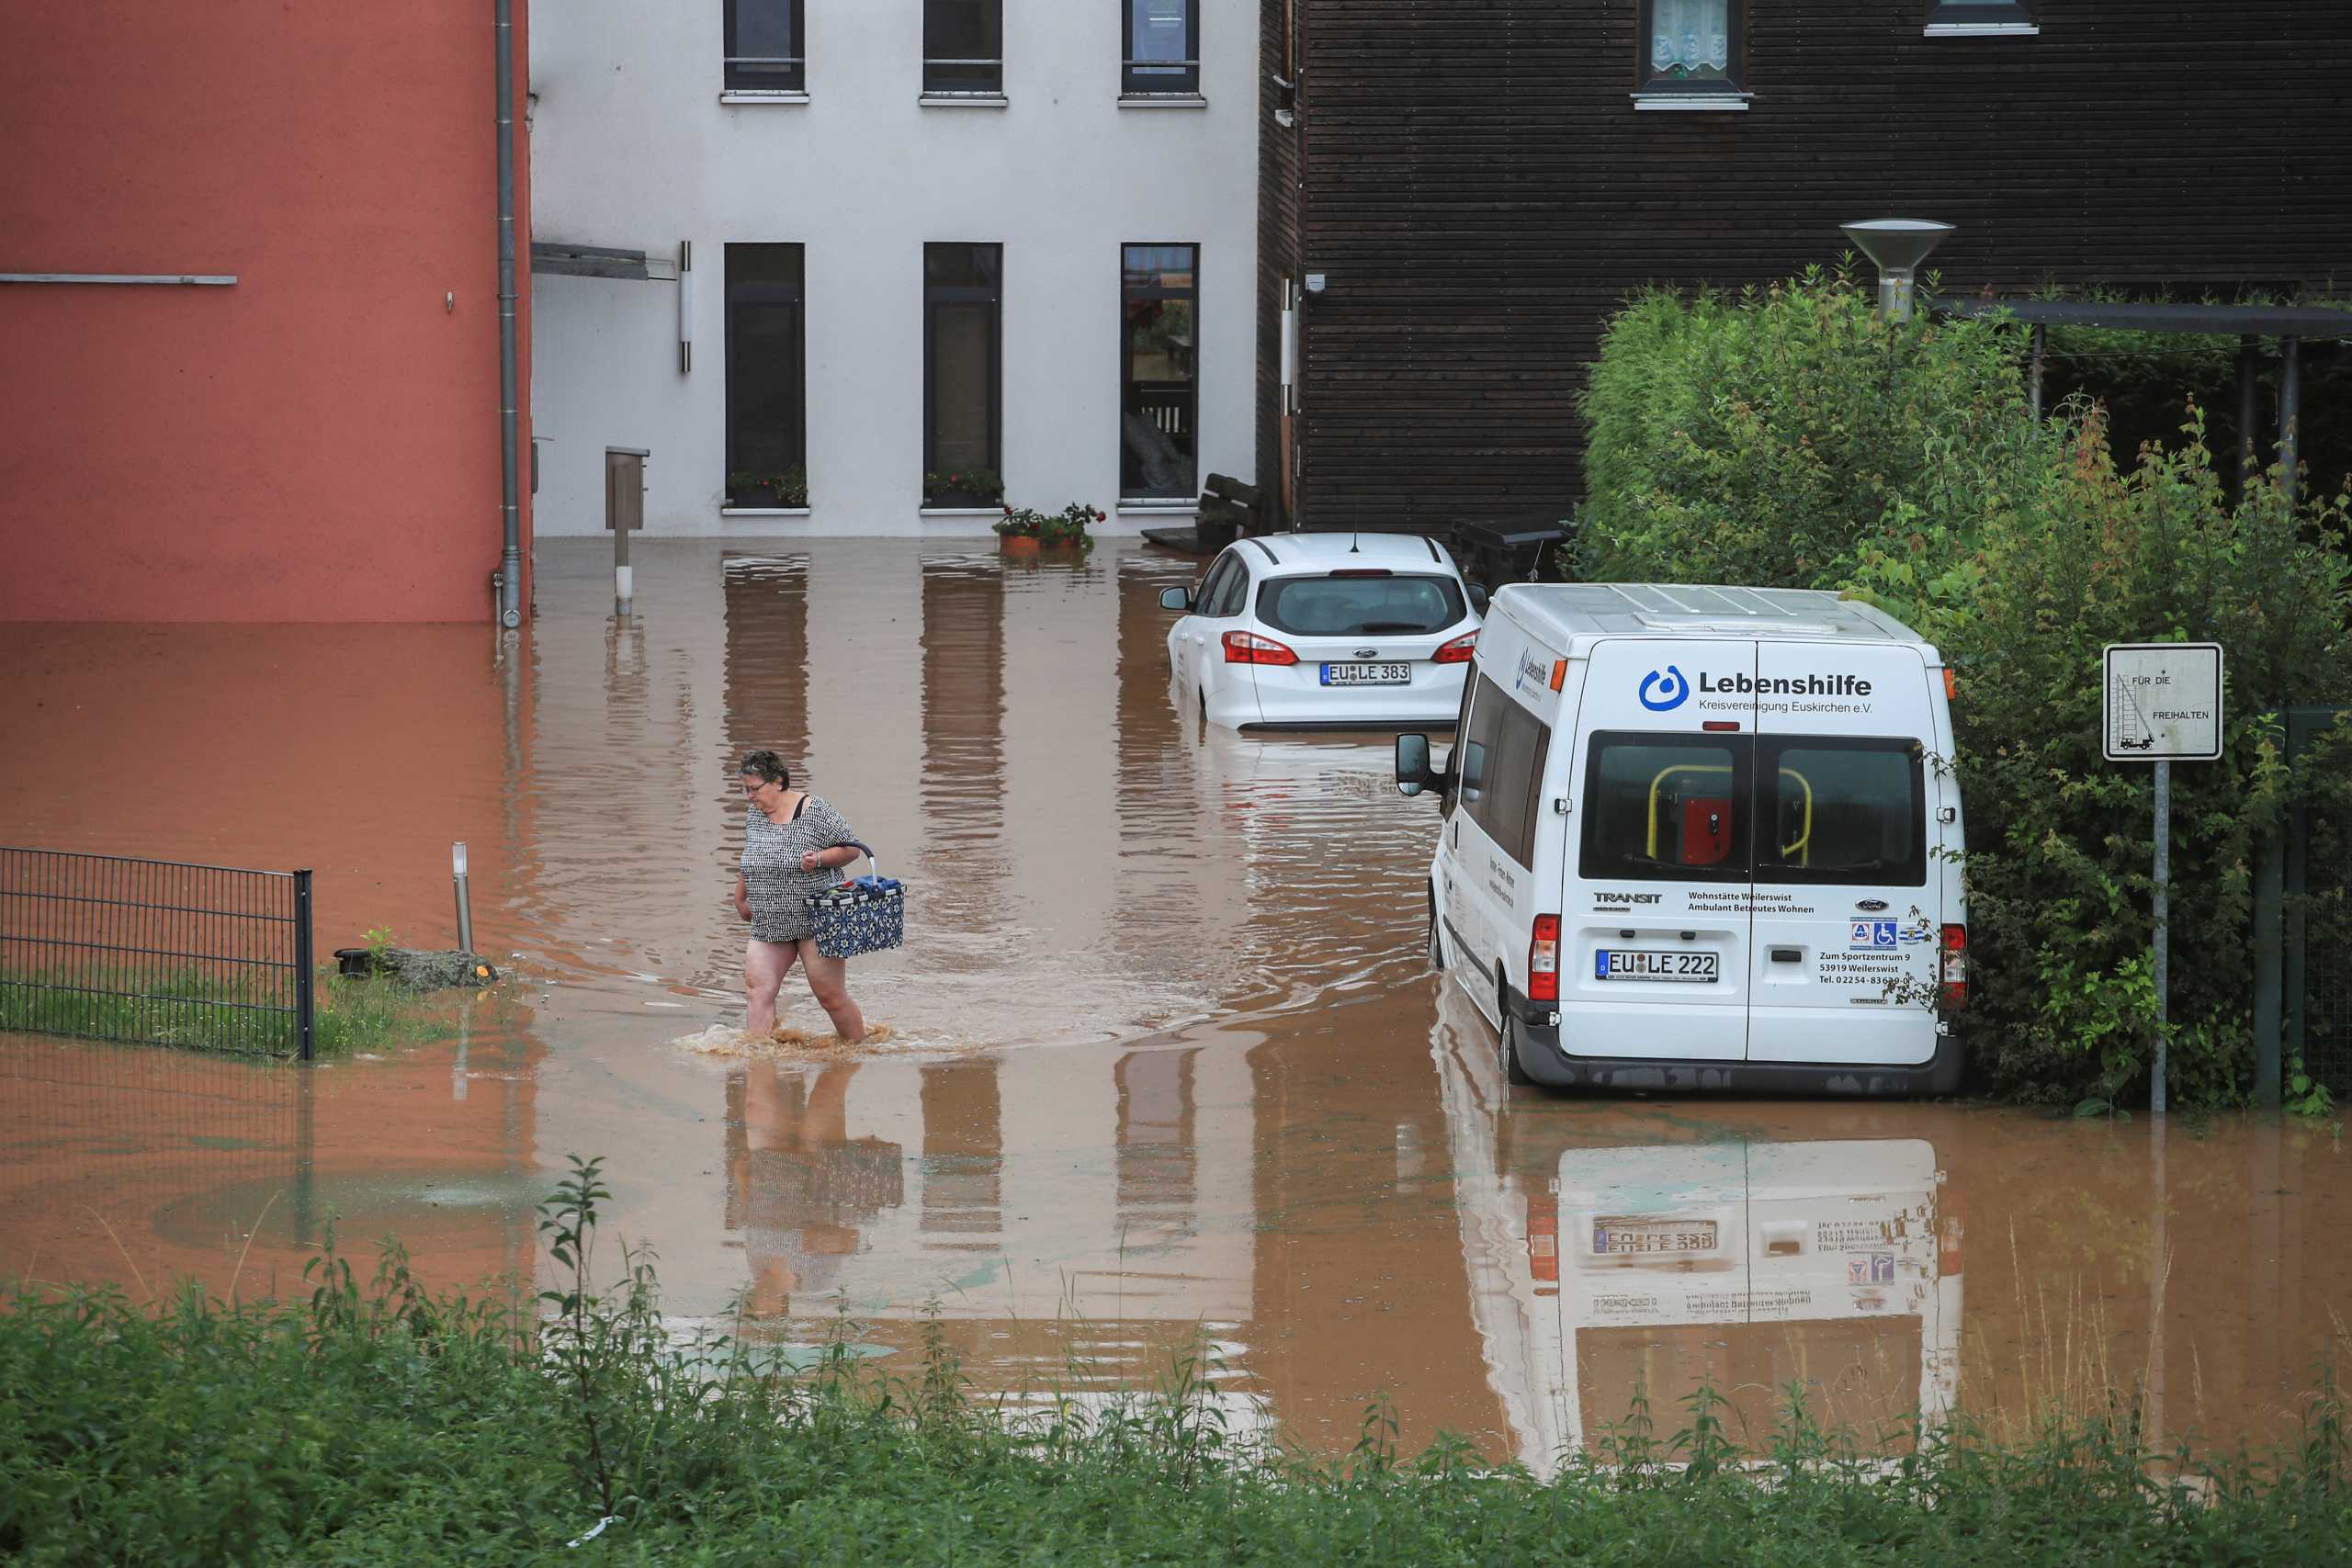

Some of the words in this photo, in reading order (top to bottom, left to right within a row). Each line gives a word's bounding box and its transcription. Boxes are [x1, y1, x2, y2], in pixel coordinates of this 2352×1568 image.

[1329, 666, 1348, 680] EU
[1359, 666, 1377, 679] LE
[1381, 665, 1408, 680] 383
[1699, 671, 1871, 696] Lebenshilfe
[2132, 676, 2151, 685] FÜR
[2155, 676, 2171, 684] DIE
[1699, 699, 1788, 714] Kreisvereinigung
[1792, 701, 1851, 713] Euskirchen
[1853, 704, 1872, 714] e.V.
[2153, 711, 2209, 719] FREIHALTEN
[1593, 892, 1663, 904] TRANSIT
[1688, 891, 1739, 901] Wohnstätte
[1741, 893, 1792, 902] Weilerswist
[1688, 903, 1733, 912] Ambulant
[1734, 904, 1777, 913] Betreutes
[1778, 905, 1815, 914] Wohnen
[1820, 952, 1839, 960] Zum
[1841, 952, 1903, 962] Sportzentrum
[1610, 954, 1634, 973] EU
[1648, 954, 1673, 974] LE
[1679, 955, 1714, 975] 222
[1819, 964, 1847, 972] 53919
[1849, 964, 1899, 973] Weilerswist
[1819, 976, 1834, 984] Tel.
